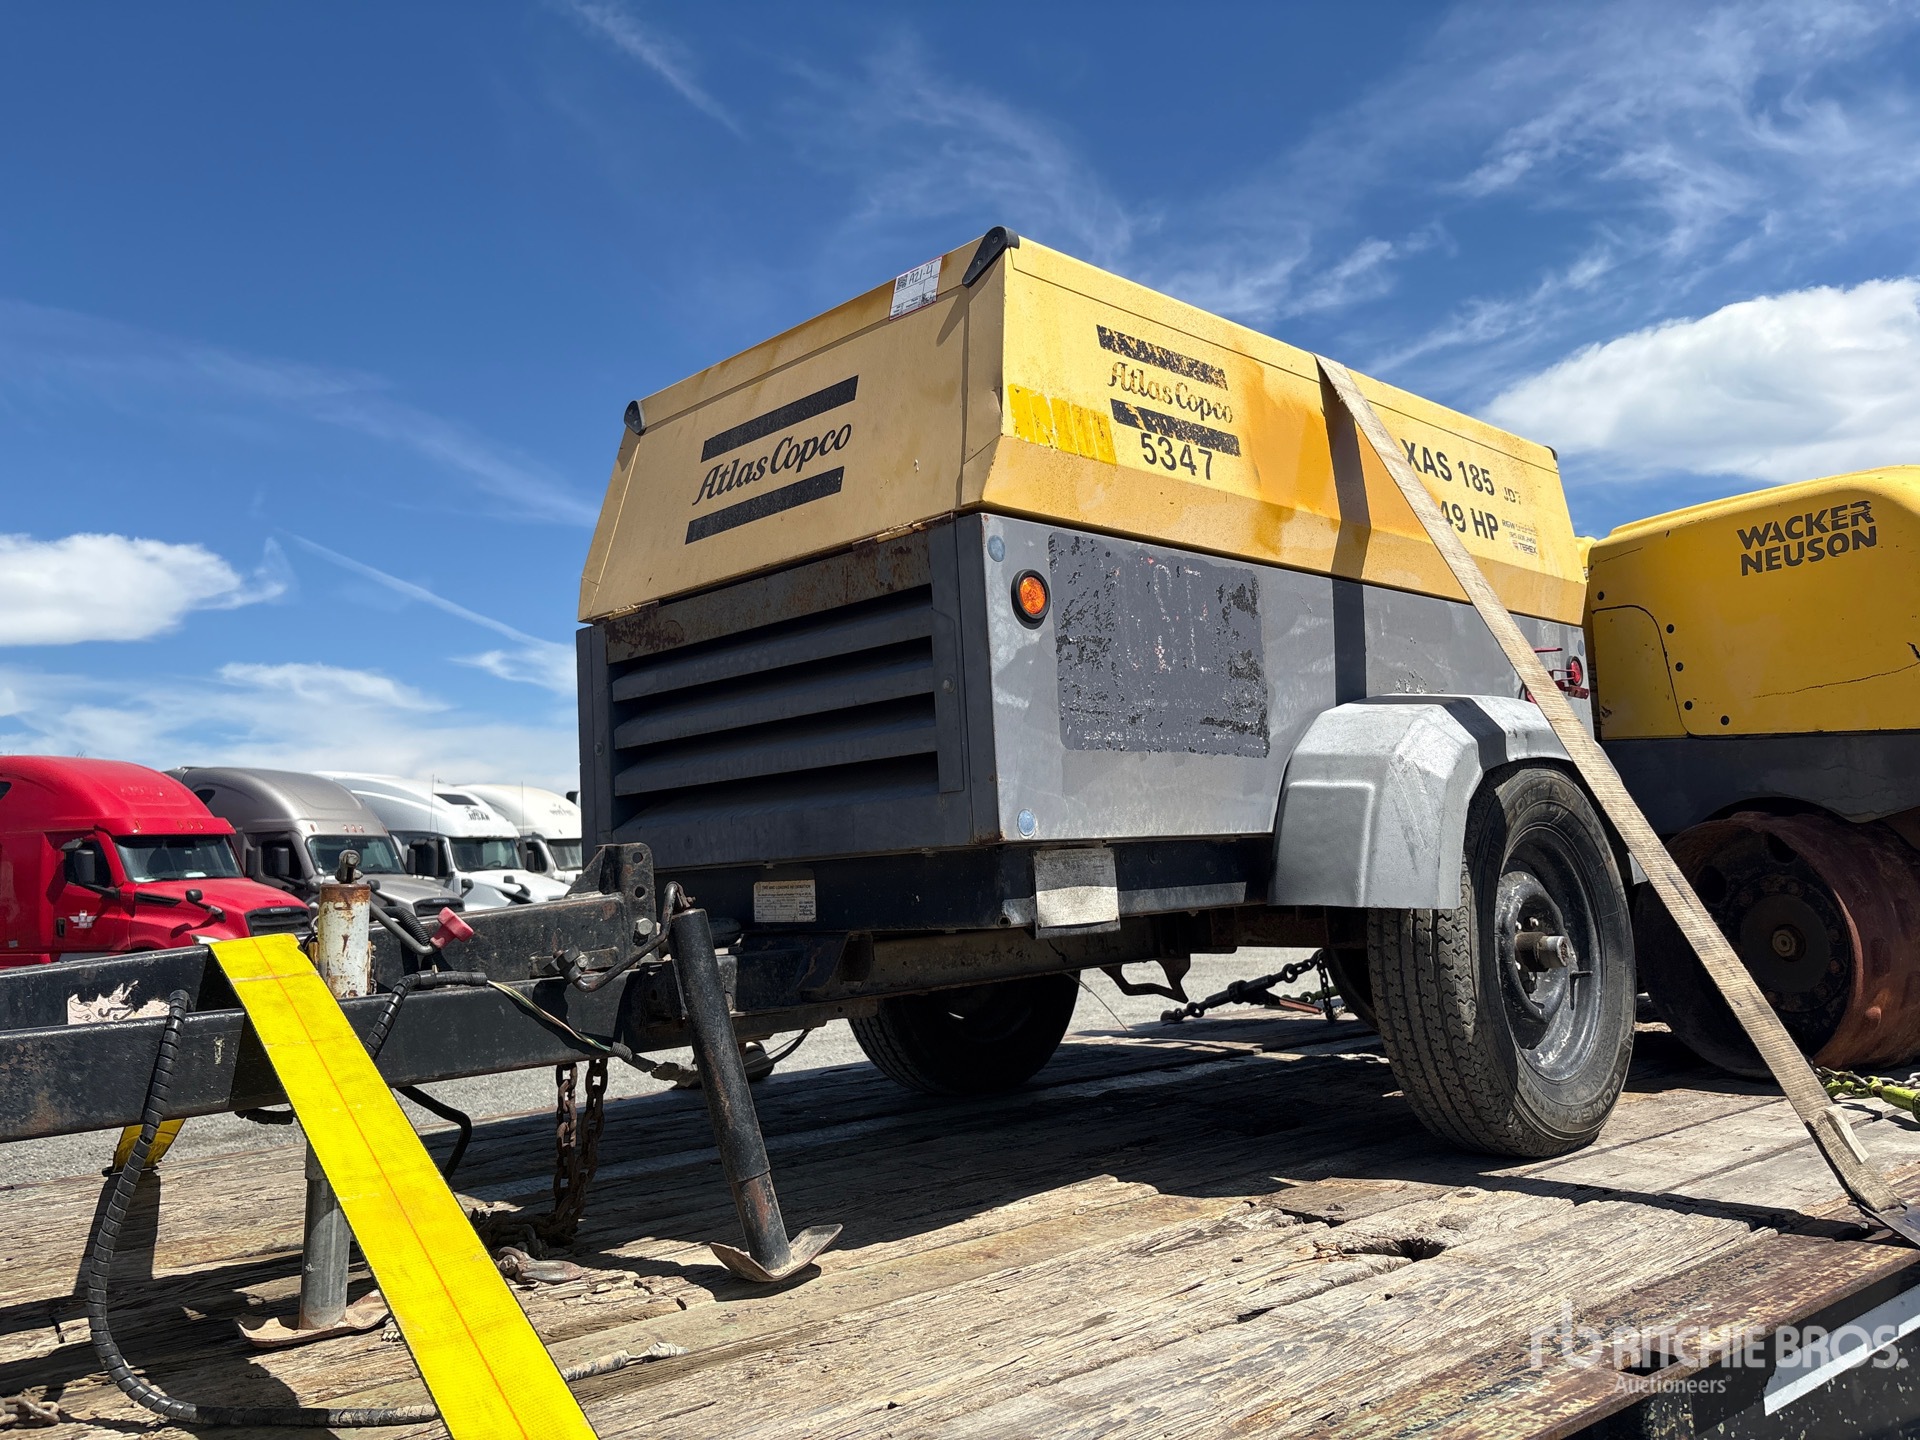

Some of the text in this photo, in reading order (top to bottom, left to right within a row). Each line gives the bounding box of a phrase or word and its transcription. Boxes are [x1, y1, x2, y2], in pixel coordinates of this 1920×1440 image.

[1107, 361, 1234, 423] Atlas Copco
[692, 423, 852, 506] Atlas Copco
[1140, 431, 1213, 480] 5347
[1400, 438, 1453, 482] XAS
[1458, 460, 1495, 496] 185
[1440, 500, 1467, 533] 49
[1470, 507, 1499, 541] HP
[1737, 500, 1875, 550] WACKER
[1740, 525, 1877, 576] NEUSON
